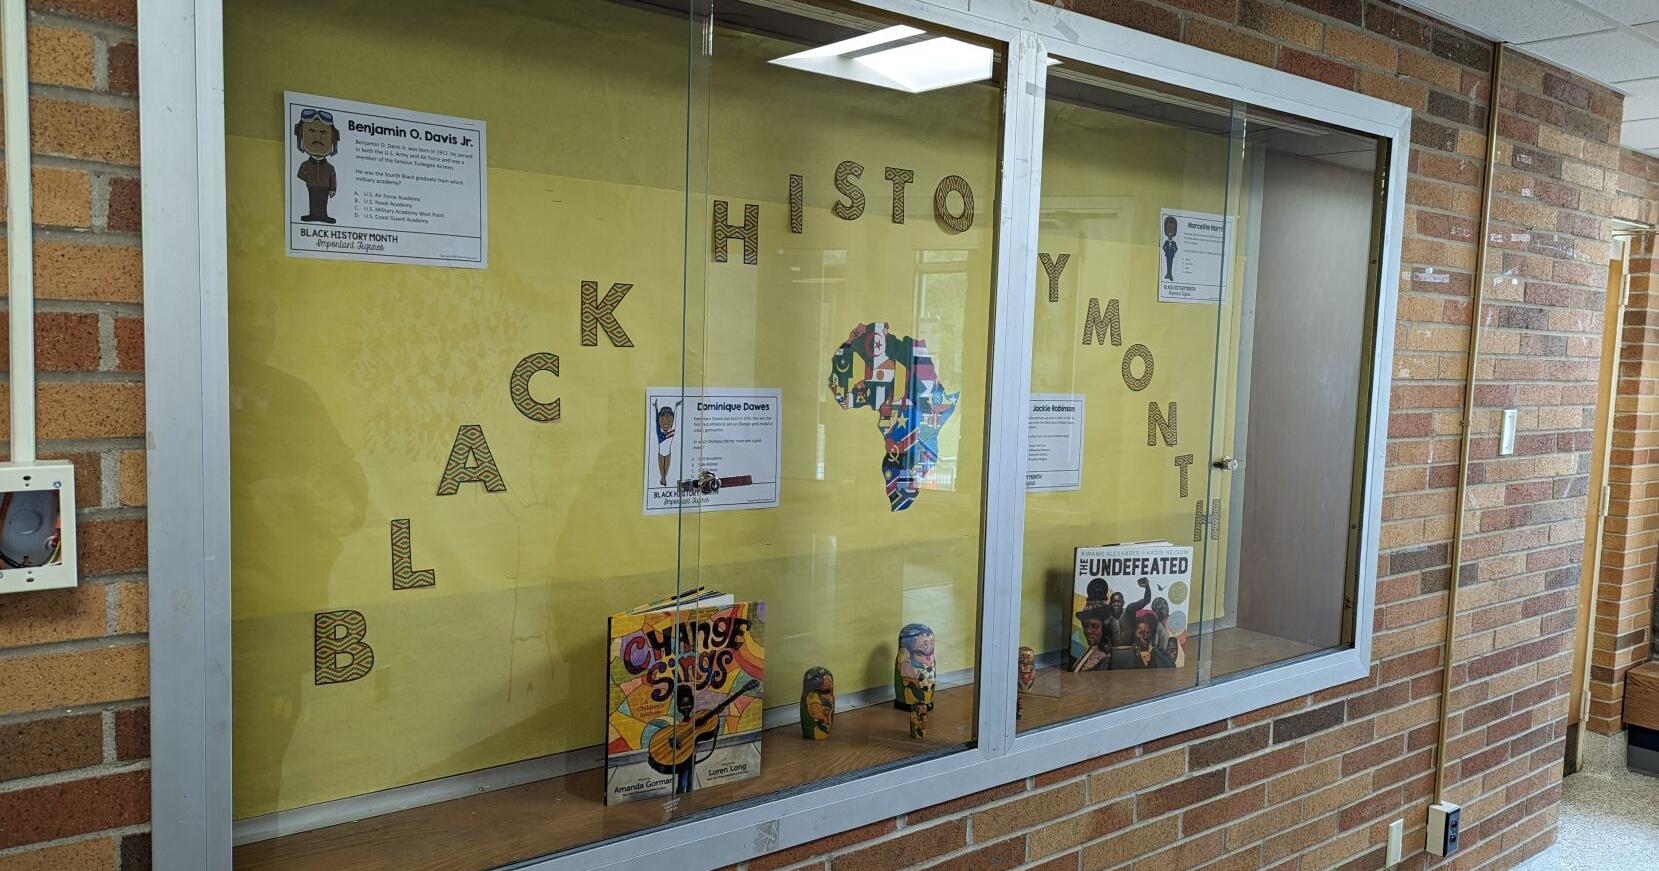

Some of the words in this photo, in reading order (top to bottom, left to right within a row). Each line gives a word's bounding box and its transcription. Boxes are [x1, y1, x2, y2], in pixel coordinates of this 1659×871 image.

[348, 120, 406, 138] Benjamin
[410, 128, 422, 140] O.
[424, 131, 458, 145] Davis
[461, 136, 474, 148] Jr.
[1211, 224, 1224, 232] Harri
[300, 228, 329, 238] BLACK
[330, 230, 368, 240] HISTORY
[369, 232, 398, 243] MONTH
[316, 238, 355, 250] Important
[356, 241, 384, 253] Figures
[697, 402, 741, 412] Dominique
[743, 402, 770, 411] Dawes
[1052, 404, 1076, 412] Robinson
[1080, 558, 1088, 576] THE
[1089, 556, 1189, 577] UNDEFEATED
[708, 767, 728, 776] Loren
[730, 764, 747, 772] Long
[614, 780, 644, 793] Amanda
